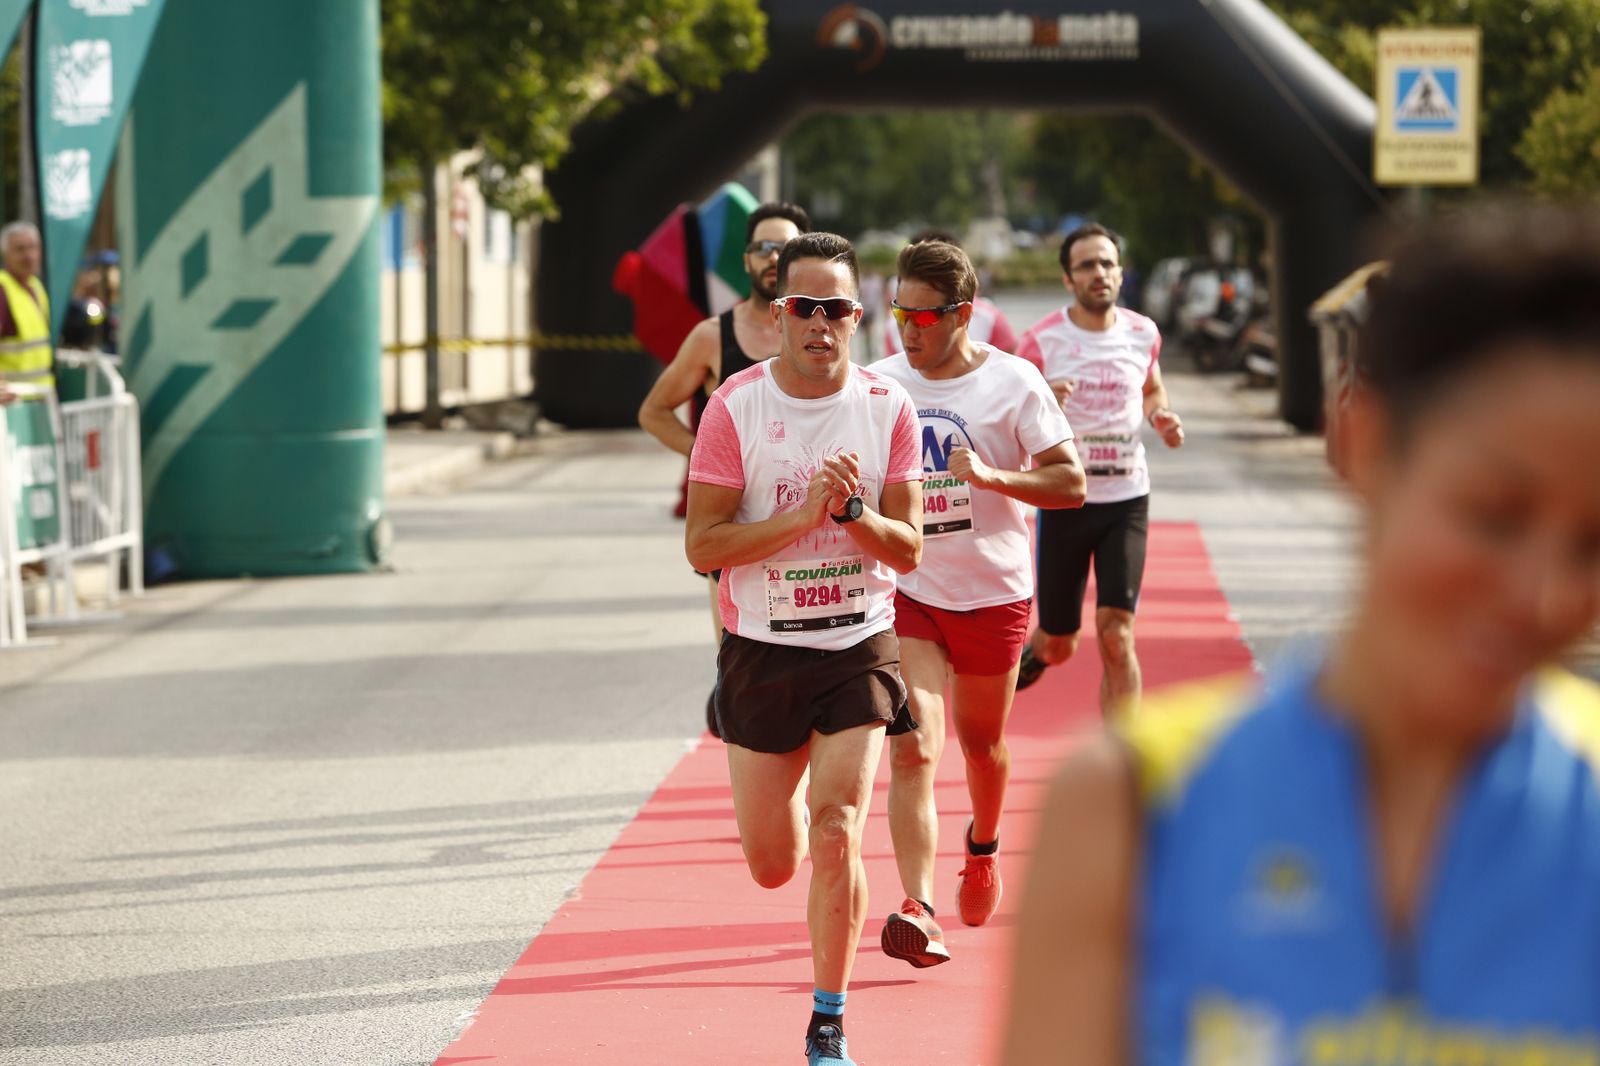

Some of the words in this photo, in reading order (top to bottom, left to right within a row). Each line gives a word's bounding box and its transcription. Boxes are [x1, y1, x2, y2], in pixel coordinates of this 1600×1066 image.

[938, 408, 953, 418] BIKE
[952, 412, 968, 428] RACE
[776, 483, 803, 505] Por
[923, 495, 948, 514] 40
[785, 564, 862, 581] COVIRAN
[794, 585, 842, 607] 9294
